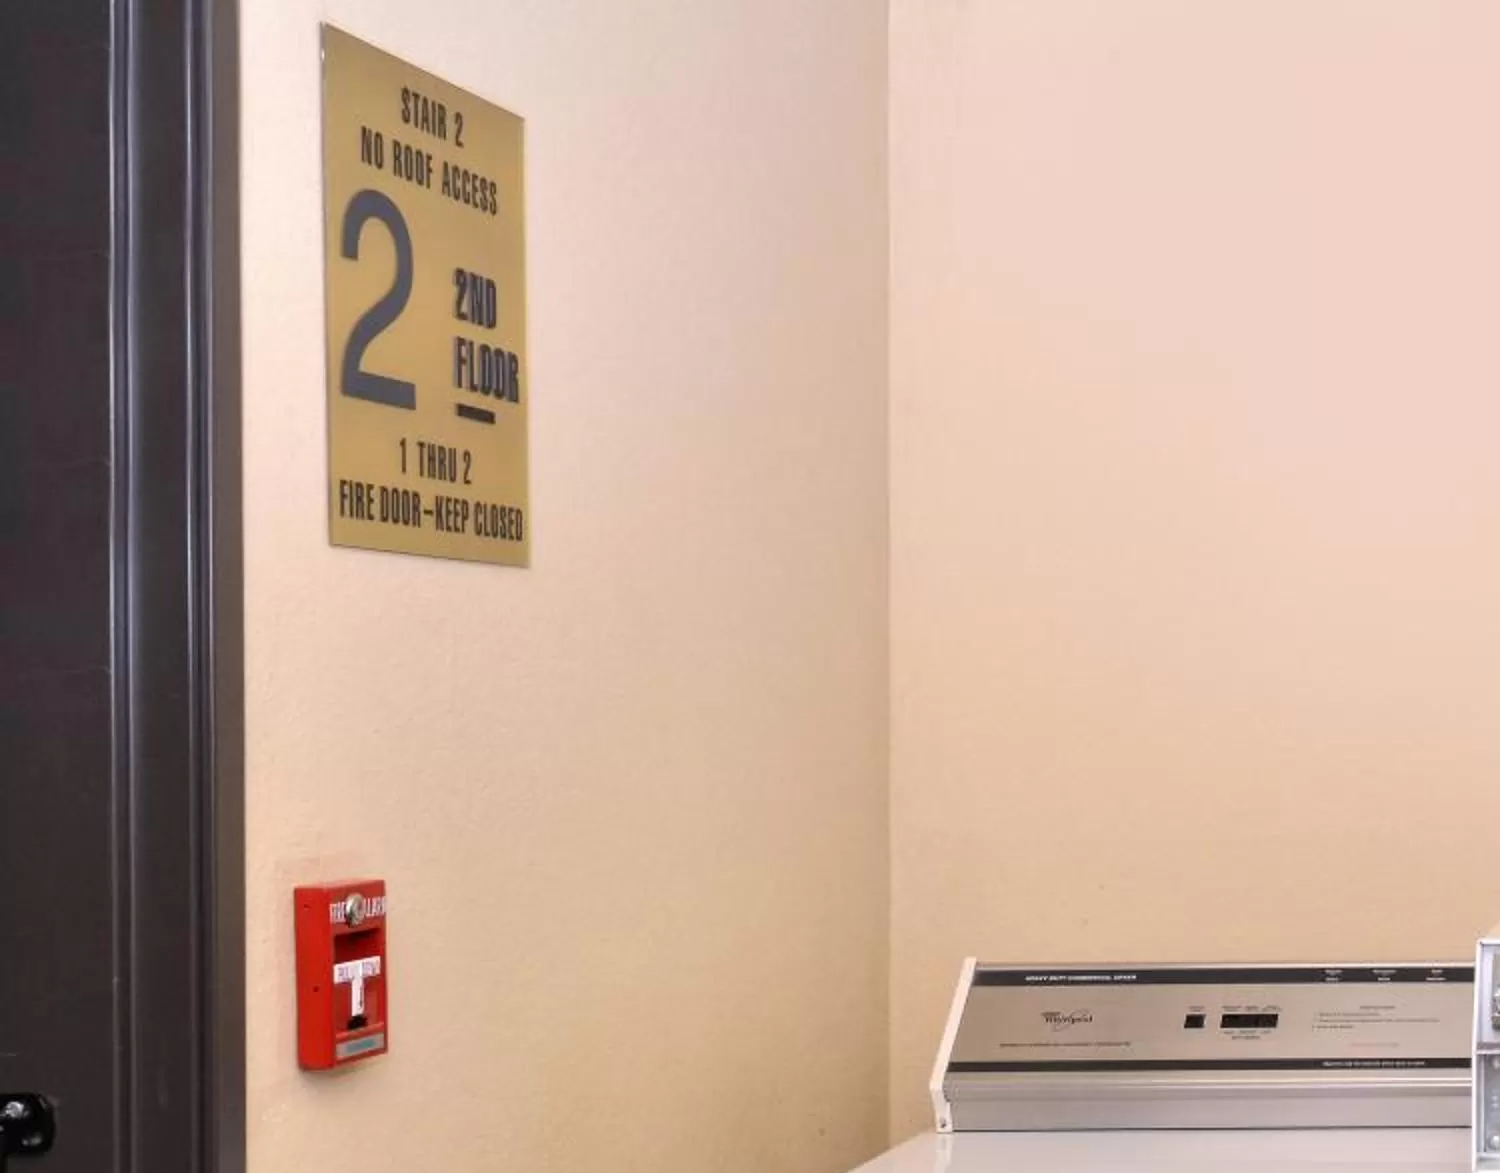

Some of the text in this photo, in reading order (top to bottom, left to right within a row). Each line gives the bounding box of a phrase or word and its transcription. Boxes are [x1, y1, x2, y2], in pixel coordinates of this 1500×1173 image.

[401, 85, 464, 148] STAIR 2
[360, 125, 497, 216] NO ROOF ACCESS
[340, 188, 417, 411] 2
[453, 267, 498, 330] 2ND
[454, 335, 520, 404] FLOOR
[400, 437, 472, 485] 1 THRU 2
[339, 479, 375, 522] FIRE
[474, 501, 523, 543] CLOSED
